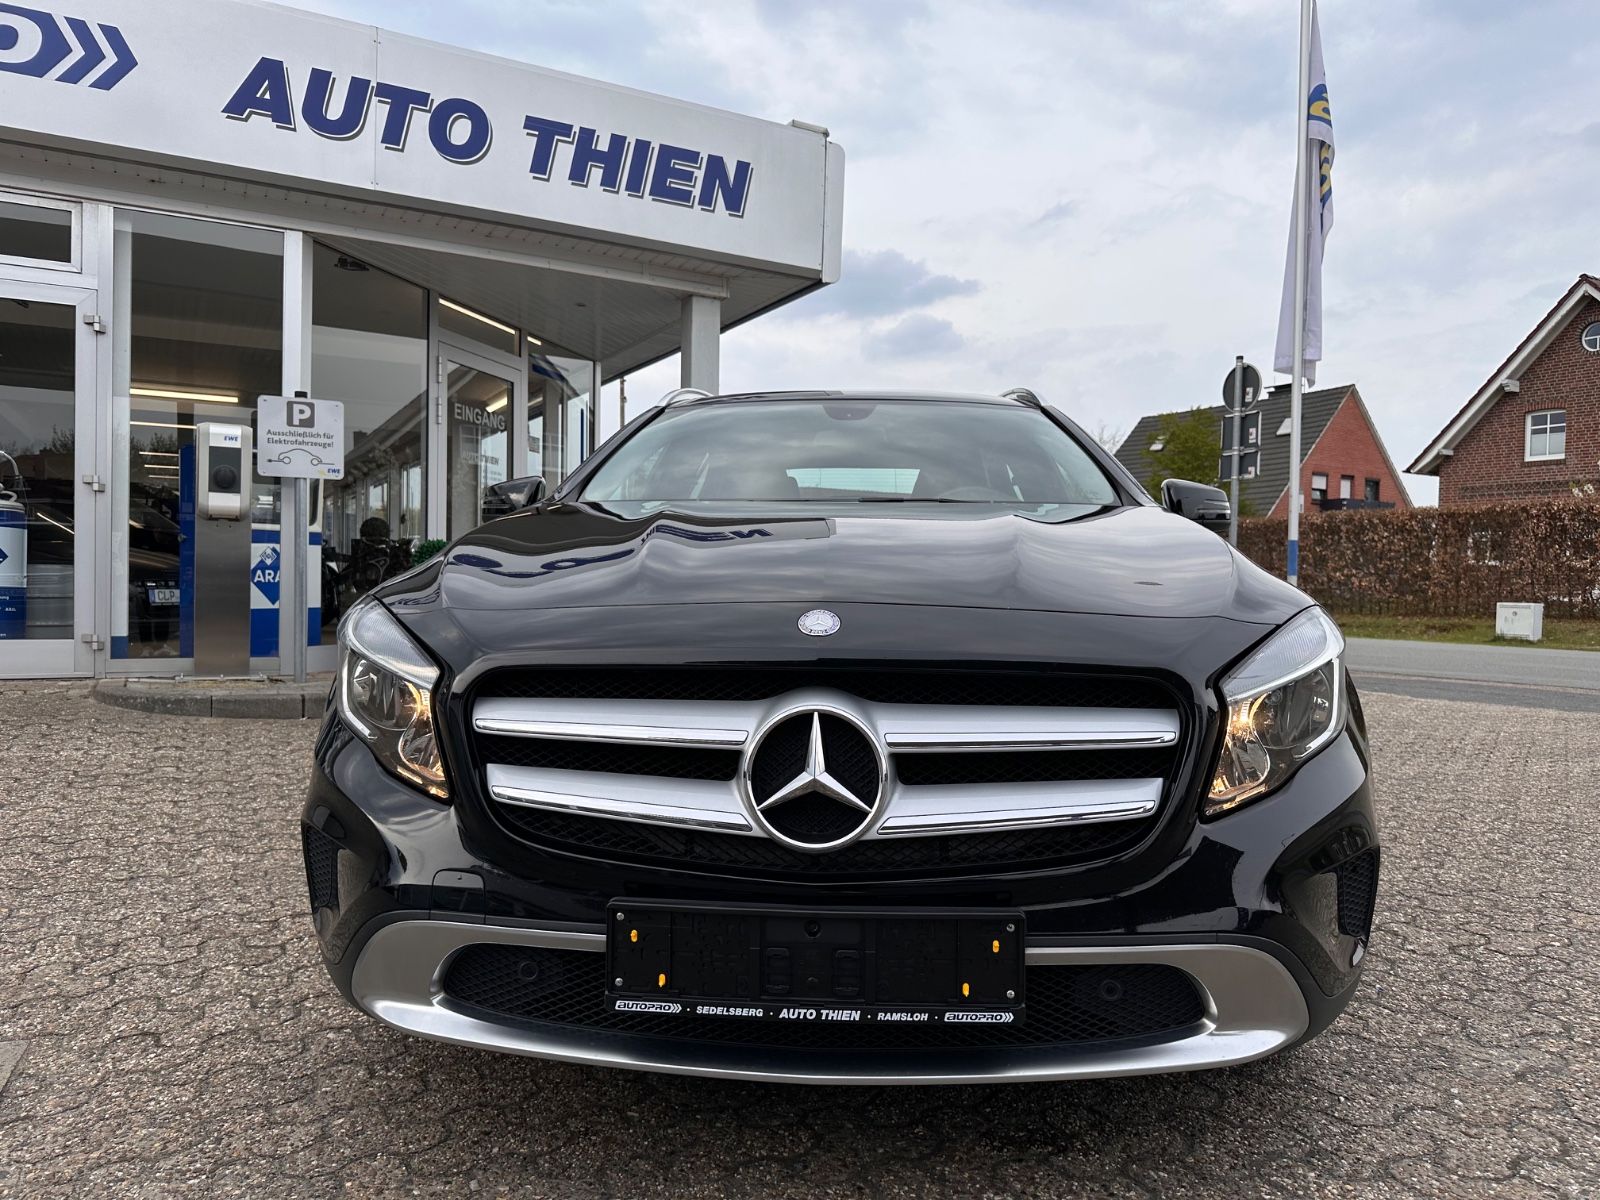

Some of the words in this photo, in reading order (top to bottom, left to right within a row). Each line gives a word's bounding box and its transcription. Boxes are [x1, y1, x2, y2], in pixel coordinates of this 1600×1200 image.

[221, 56, 491, 163] AUTO
[523, 115, 752, 217] THIEN
[293, 403, 312, 426] P
[454, 403, 506, 430] EINGANG
[266, 429, 322, 439] Ausschließlich
[323, 432, 335, 440] für
[267, 437, 334, 449] Elektrofahrzeuge!
[696, 1006, 763, 1017] SEDELSBERG
[779, 1008, 817, 1020] AUTO
[820, 1009, 861, 1021] THIEN
[877, 1012, 929, 1021] RAMSLOH
